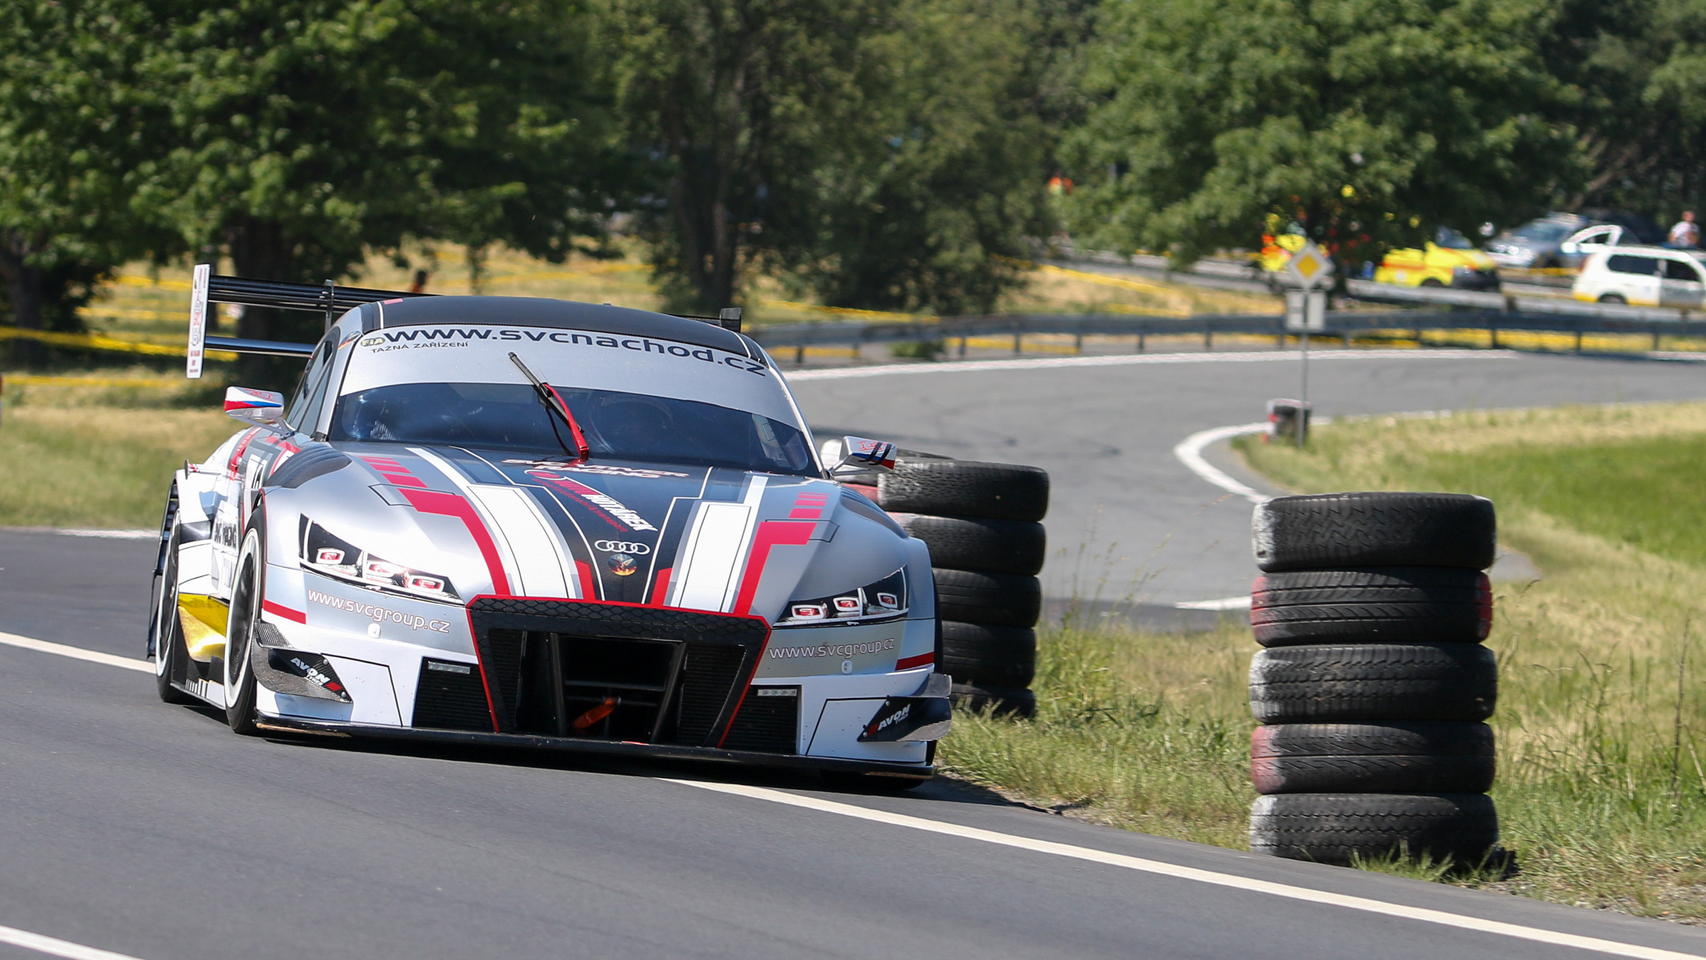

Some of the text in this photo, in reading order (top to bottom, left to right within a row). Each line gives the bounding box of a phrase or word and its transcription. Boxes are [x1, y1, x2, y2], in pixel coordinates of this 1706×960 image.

[384, 329, 766, 377] www.svcnachod.cz
[308, 589, 451, 633] www.svcgroup.cz
[769, 637, 894, 659] www.svcgroup.cz
[290, 657, 331, 684] AVON
[877, 704, 911, 731] AVON
